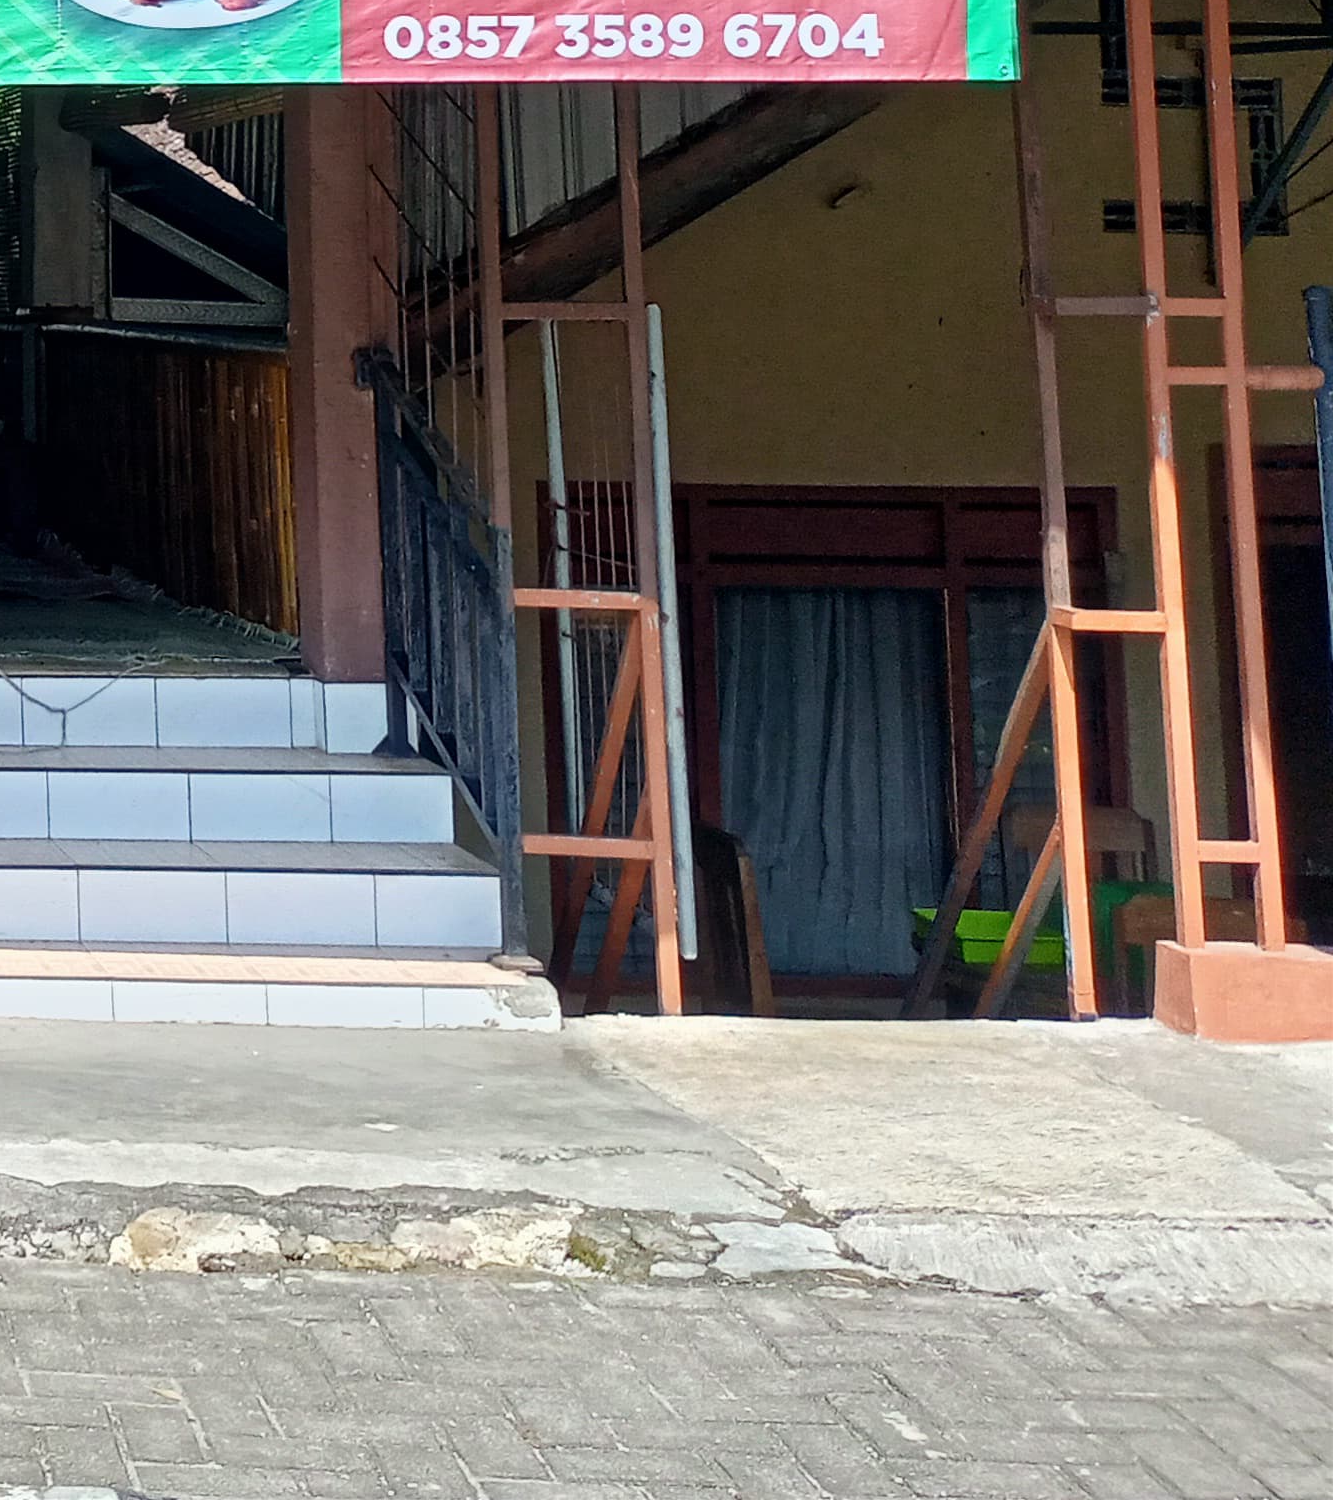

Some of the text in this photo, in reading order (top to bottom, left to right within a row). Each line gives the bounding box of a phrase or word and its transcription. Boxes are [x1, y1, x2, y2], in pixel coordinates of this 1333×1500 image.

[382, 11, 885, 61] 0857 3589 6704
